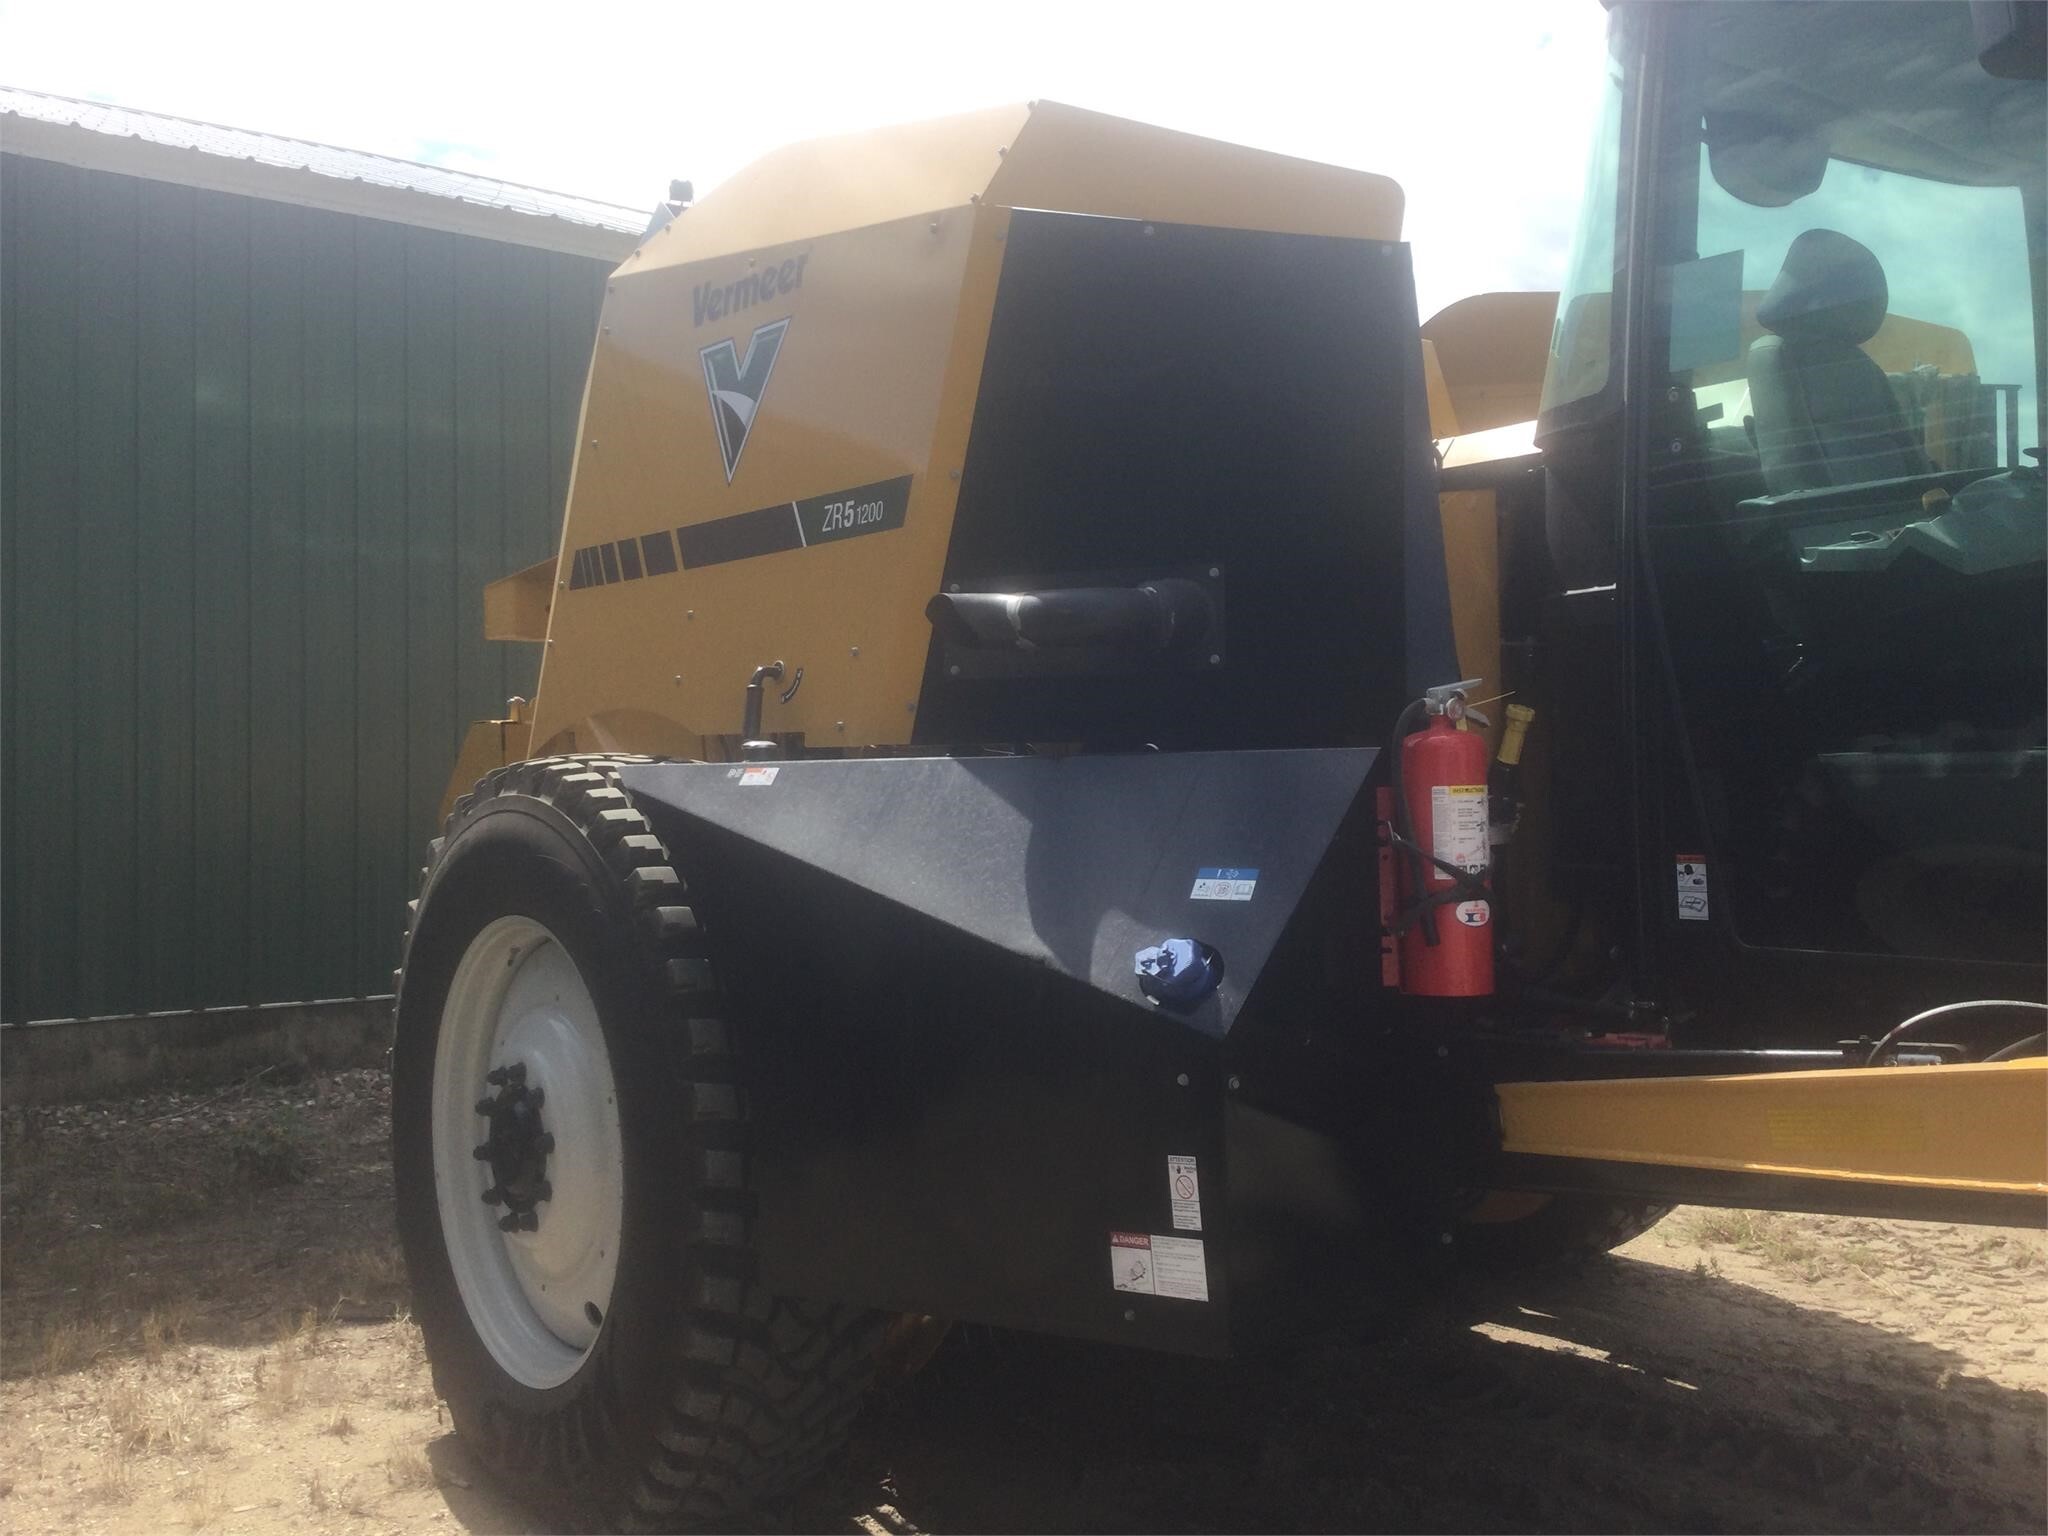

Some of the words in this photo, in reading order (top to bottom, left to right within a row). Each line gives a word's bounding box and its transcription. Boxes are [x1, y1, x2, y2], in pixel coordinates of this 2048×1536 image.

[694, 253, 808, 327] Vermeer
[857, 501, 883, 525] 1200
[1119, 1235, 1150, 1247] DANGER
